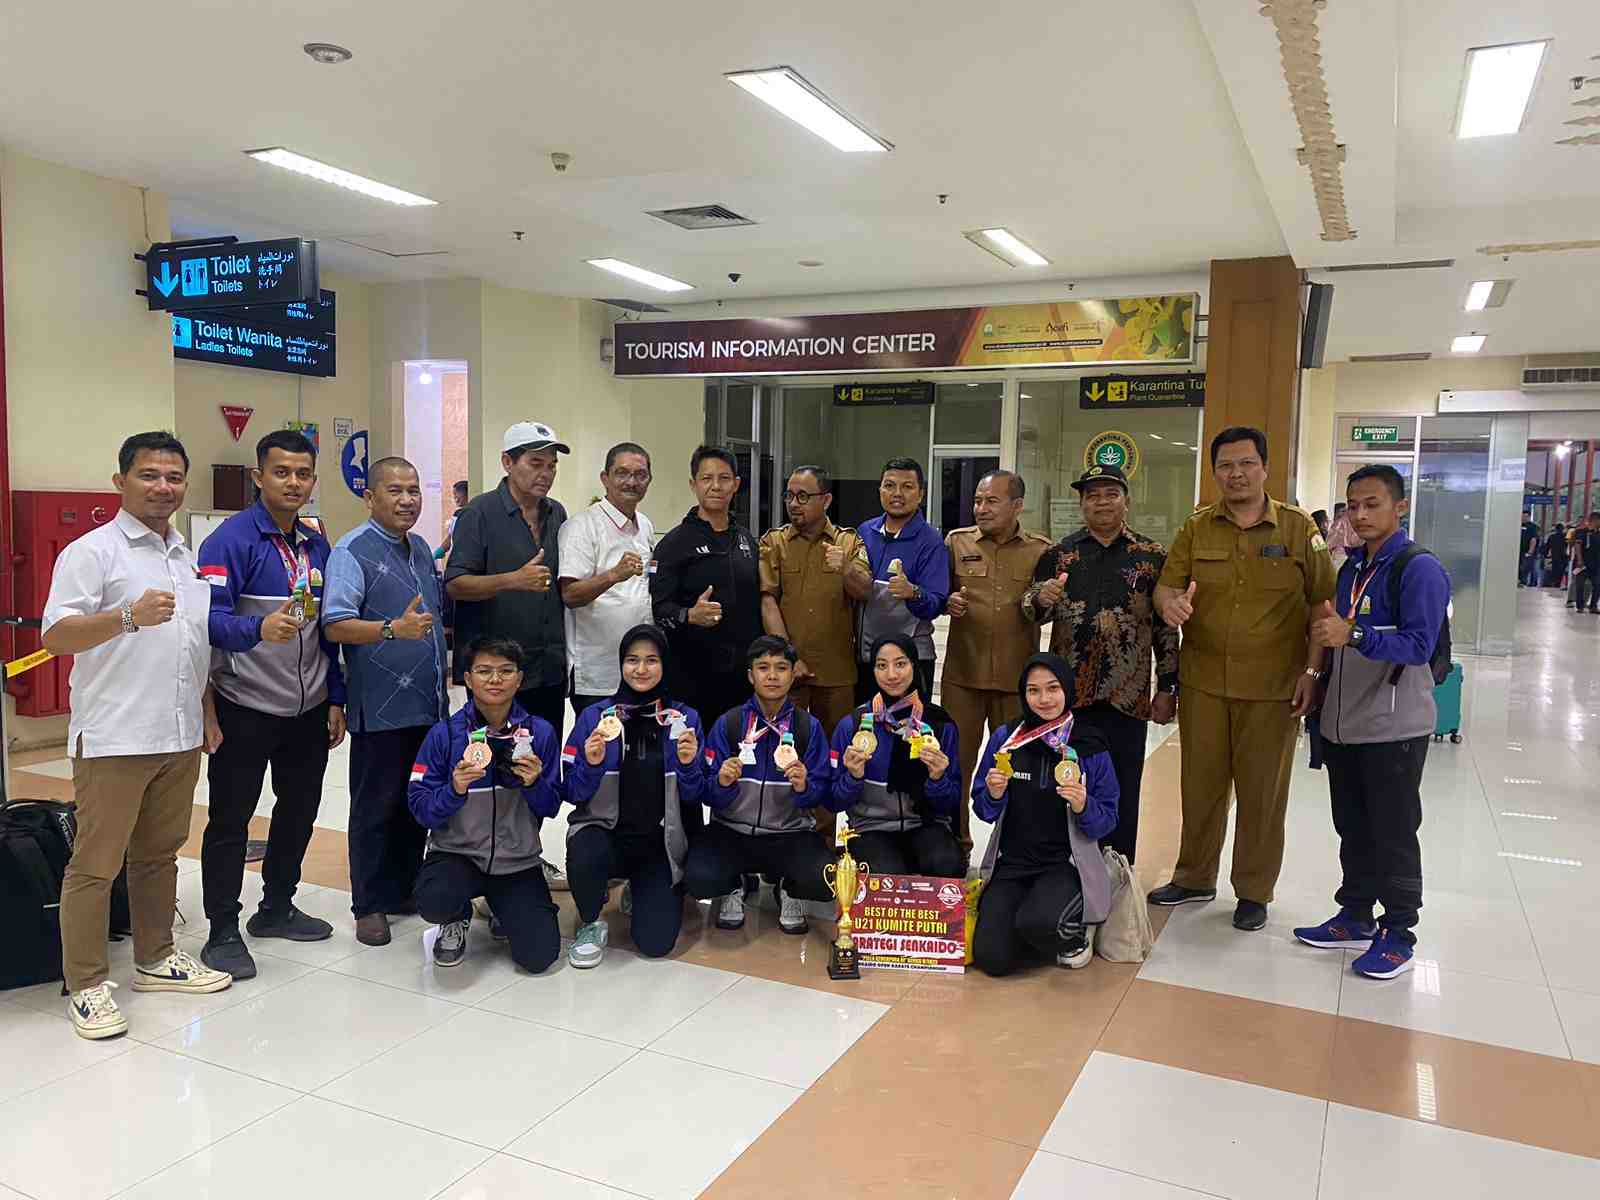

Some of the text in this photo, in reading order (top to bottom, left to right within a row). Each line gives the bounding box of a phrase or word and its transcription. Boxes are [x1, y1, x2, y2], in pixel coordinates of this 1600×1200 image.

[210, 255, 251, 276] Toilet
[211, 279, 244, 294] Toilets
[194, 319, 233, 342] Toilet
[236, 326, 283, 349] Wanita
[195, 340, 254, 358] Ladies Toilets
[624, 332, 936, 360] TOURISM INFORMATION CENTER
[1129, 380, 1185, 392] Karantina
[864, 905, 939, 921] BEST OF THE BEST
[854, 917, 947, 934] U21 KUMITE PUTRI
[853, 936, 957, 954] ARATEGI SENKAIDO
